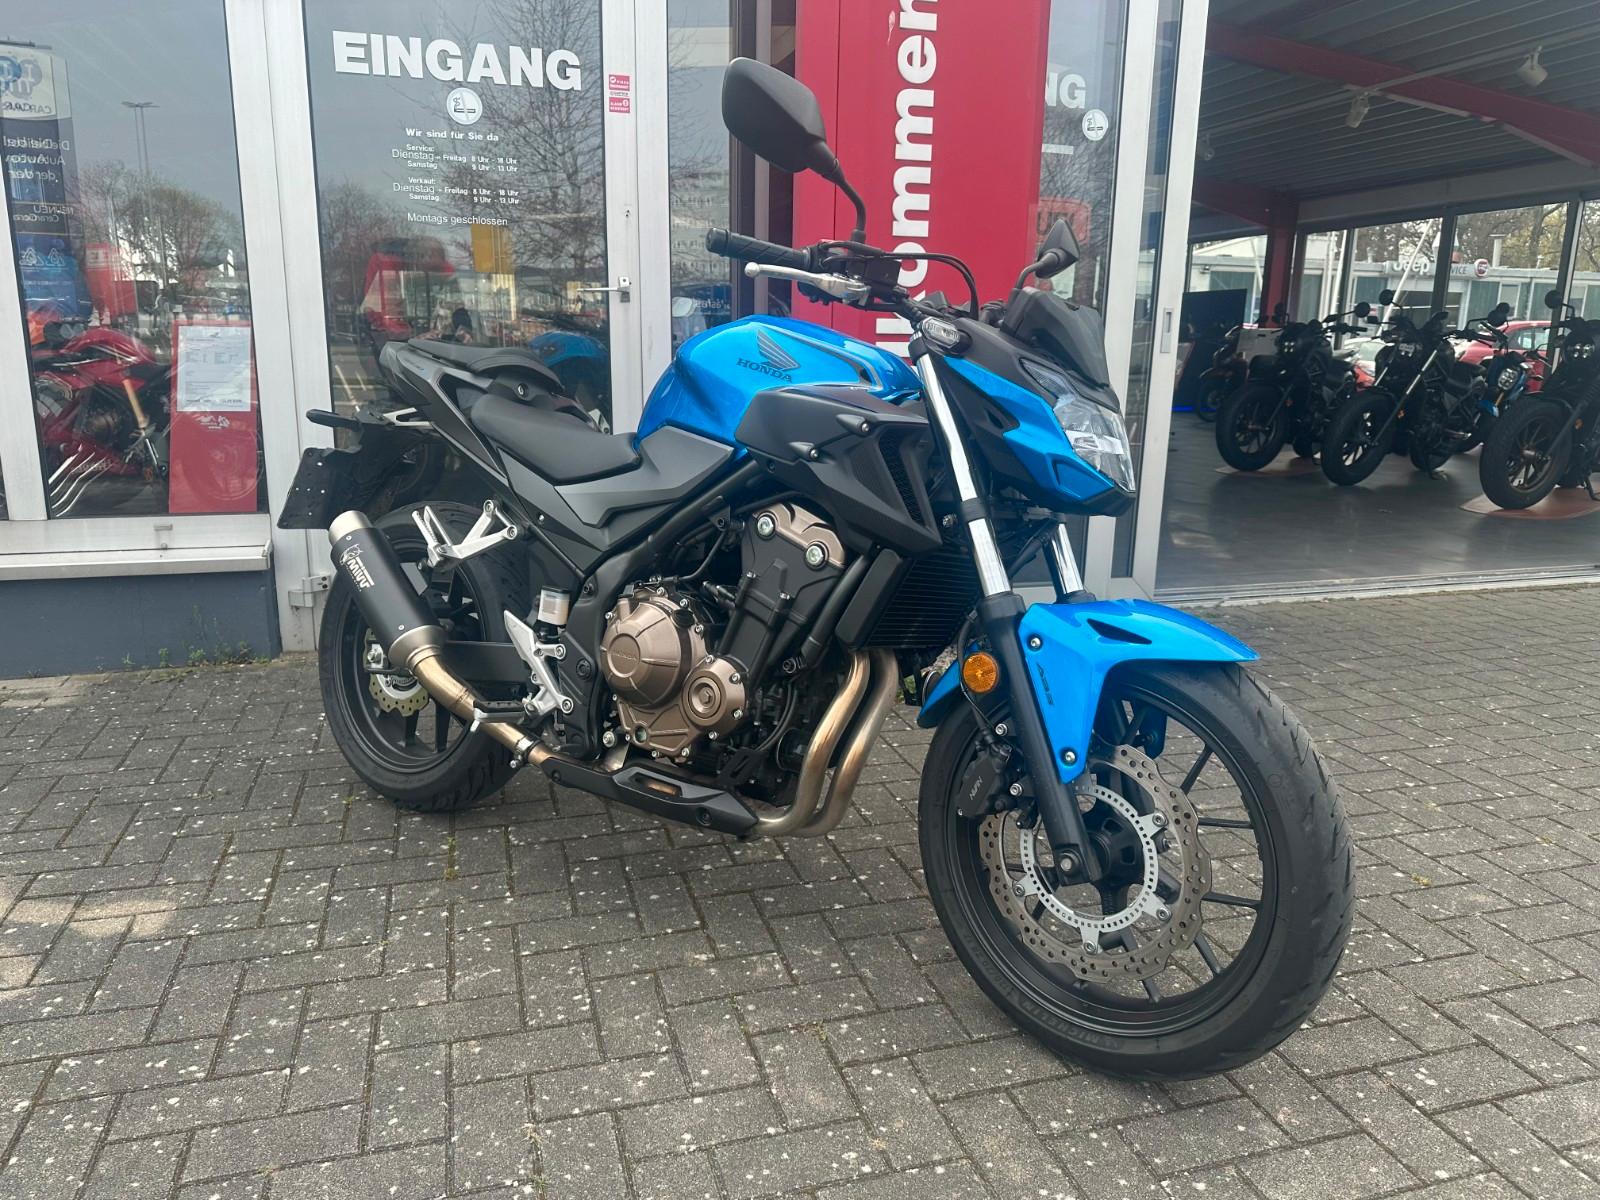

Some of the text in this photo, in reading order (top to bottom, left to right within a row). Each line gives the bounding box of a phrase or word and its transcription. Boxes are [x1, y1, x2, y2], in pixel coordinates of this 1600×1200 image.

[332, 30, 582, 91] EINGANG
[405, 127, 499, 141] Wir sind für Sie da
[406, 143, 434, 152] Service:
[391, 149, 434, 162] Dienstag
[442, 154, 467, 163] Freitag
[407, 161, 438, 170] Samstag
[408, 176, 436, 185] Verkauf:
[392, 182, 435, 194] Dienstag
[444, 186, 468, 195] Freitag
[408, 193, 439, 202] Samstag
[407, 212, 508, 226] Montags geschlossen
[736, 357, 792, 383] HONDA
